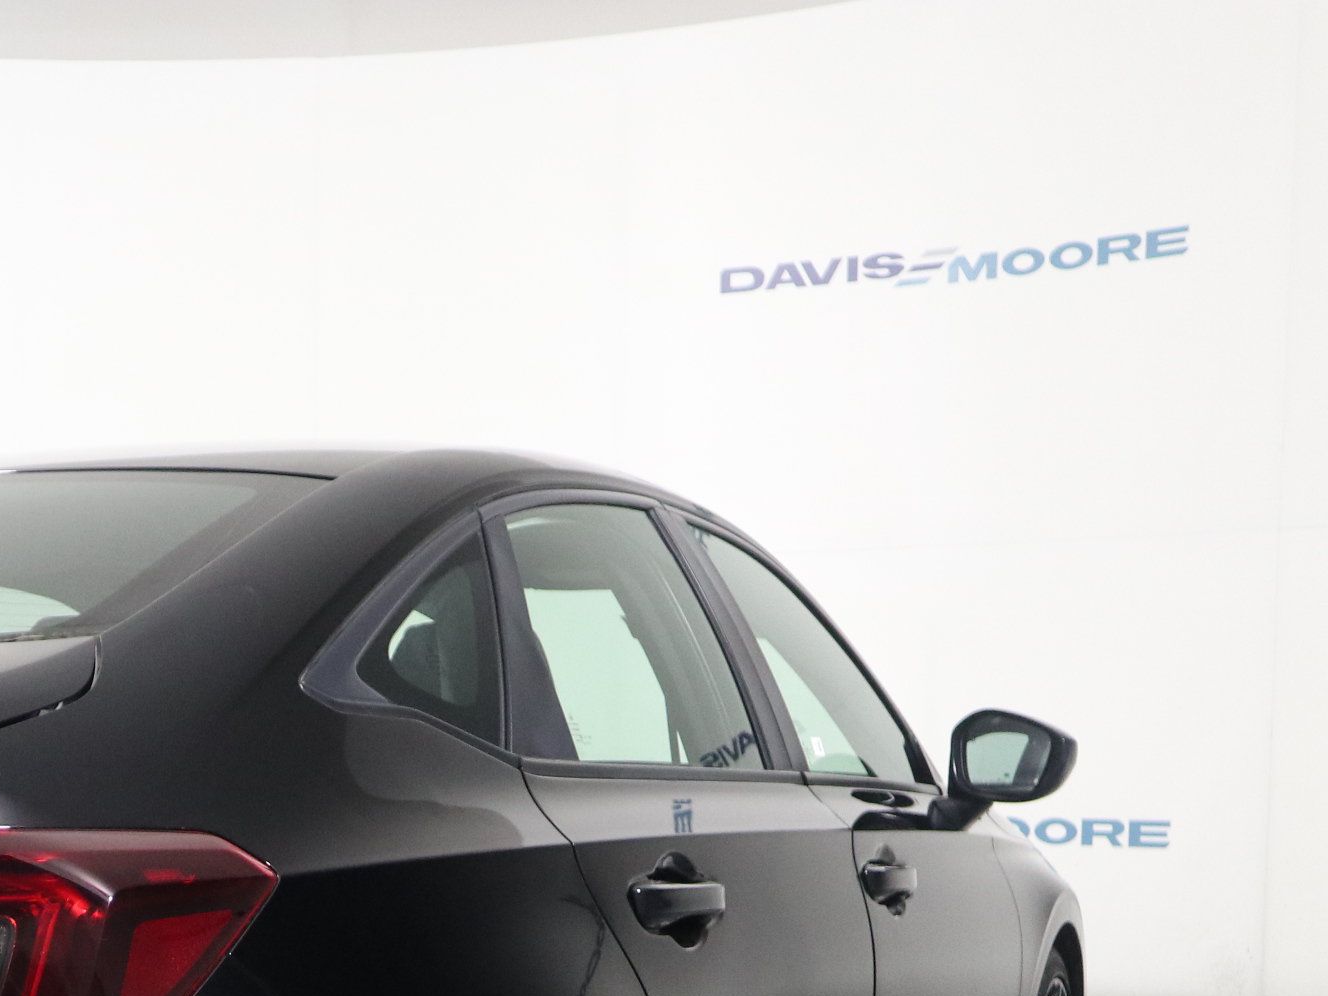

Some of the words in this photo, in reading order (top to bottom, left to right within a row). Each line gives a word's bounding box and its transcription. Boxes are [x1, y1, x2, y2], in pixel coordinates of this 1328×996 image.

[719, 251, 905, 294] DAVIS
[947, 224, 1190, 283] MOORE
[1007, 816, 1171, 848] ORE
